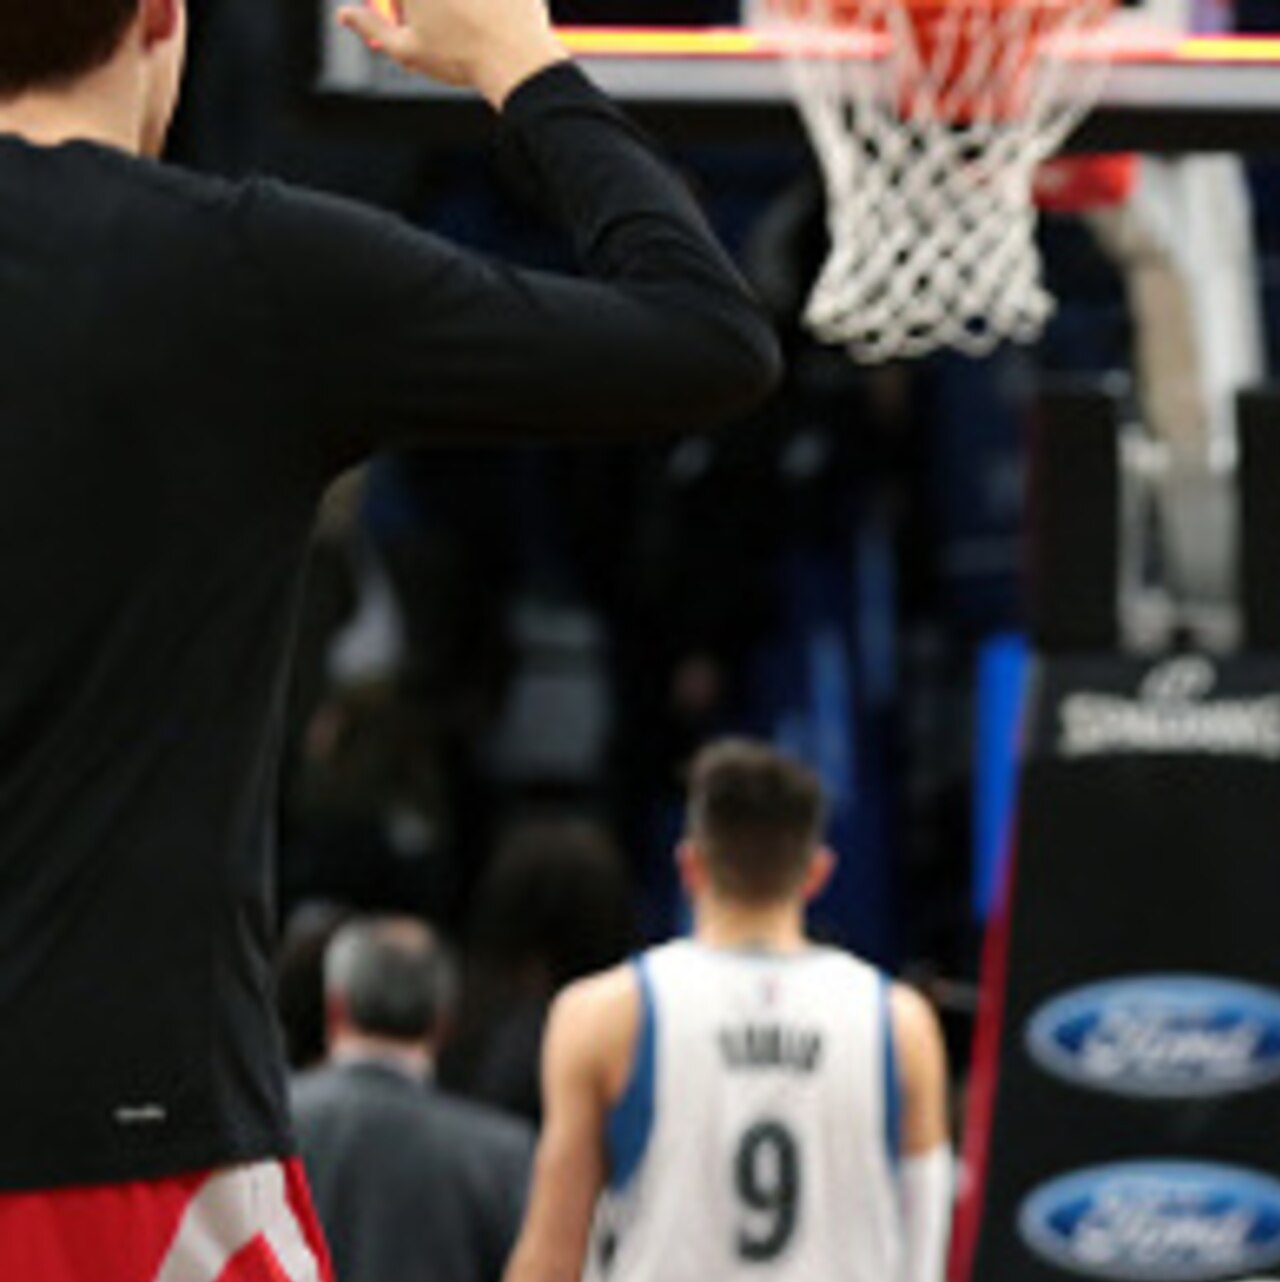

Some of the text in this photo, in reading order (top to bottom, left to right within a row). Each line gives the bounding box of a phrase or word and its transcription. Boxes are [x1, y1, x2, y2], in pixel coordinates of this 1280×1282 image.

[1078, 1000, 1264, 1081] Ford
[733, 1116, 802, 1264] 9
[1070, 1187, 1256, 1267] Ford
